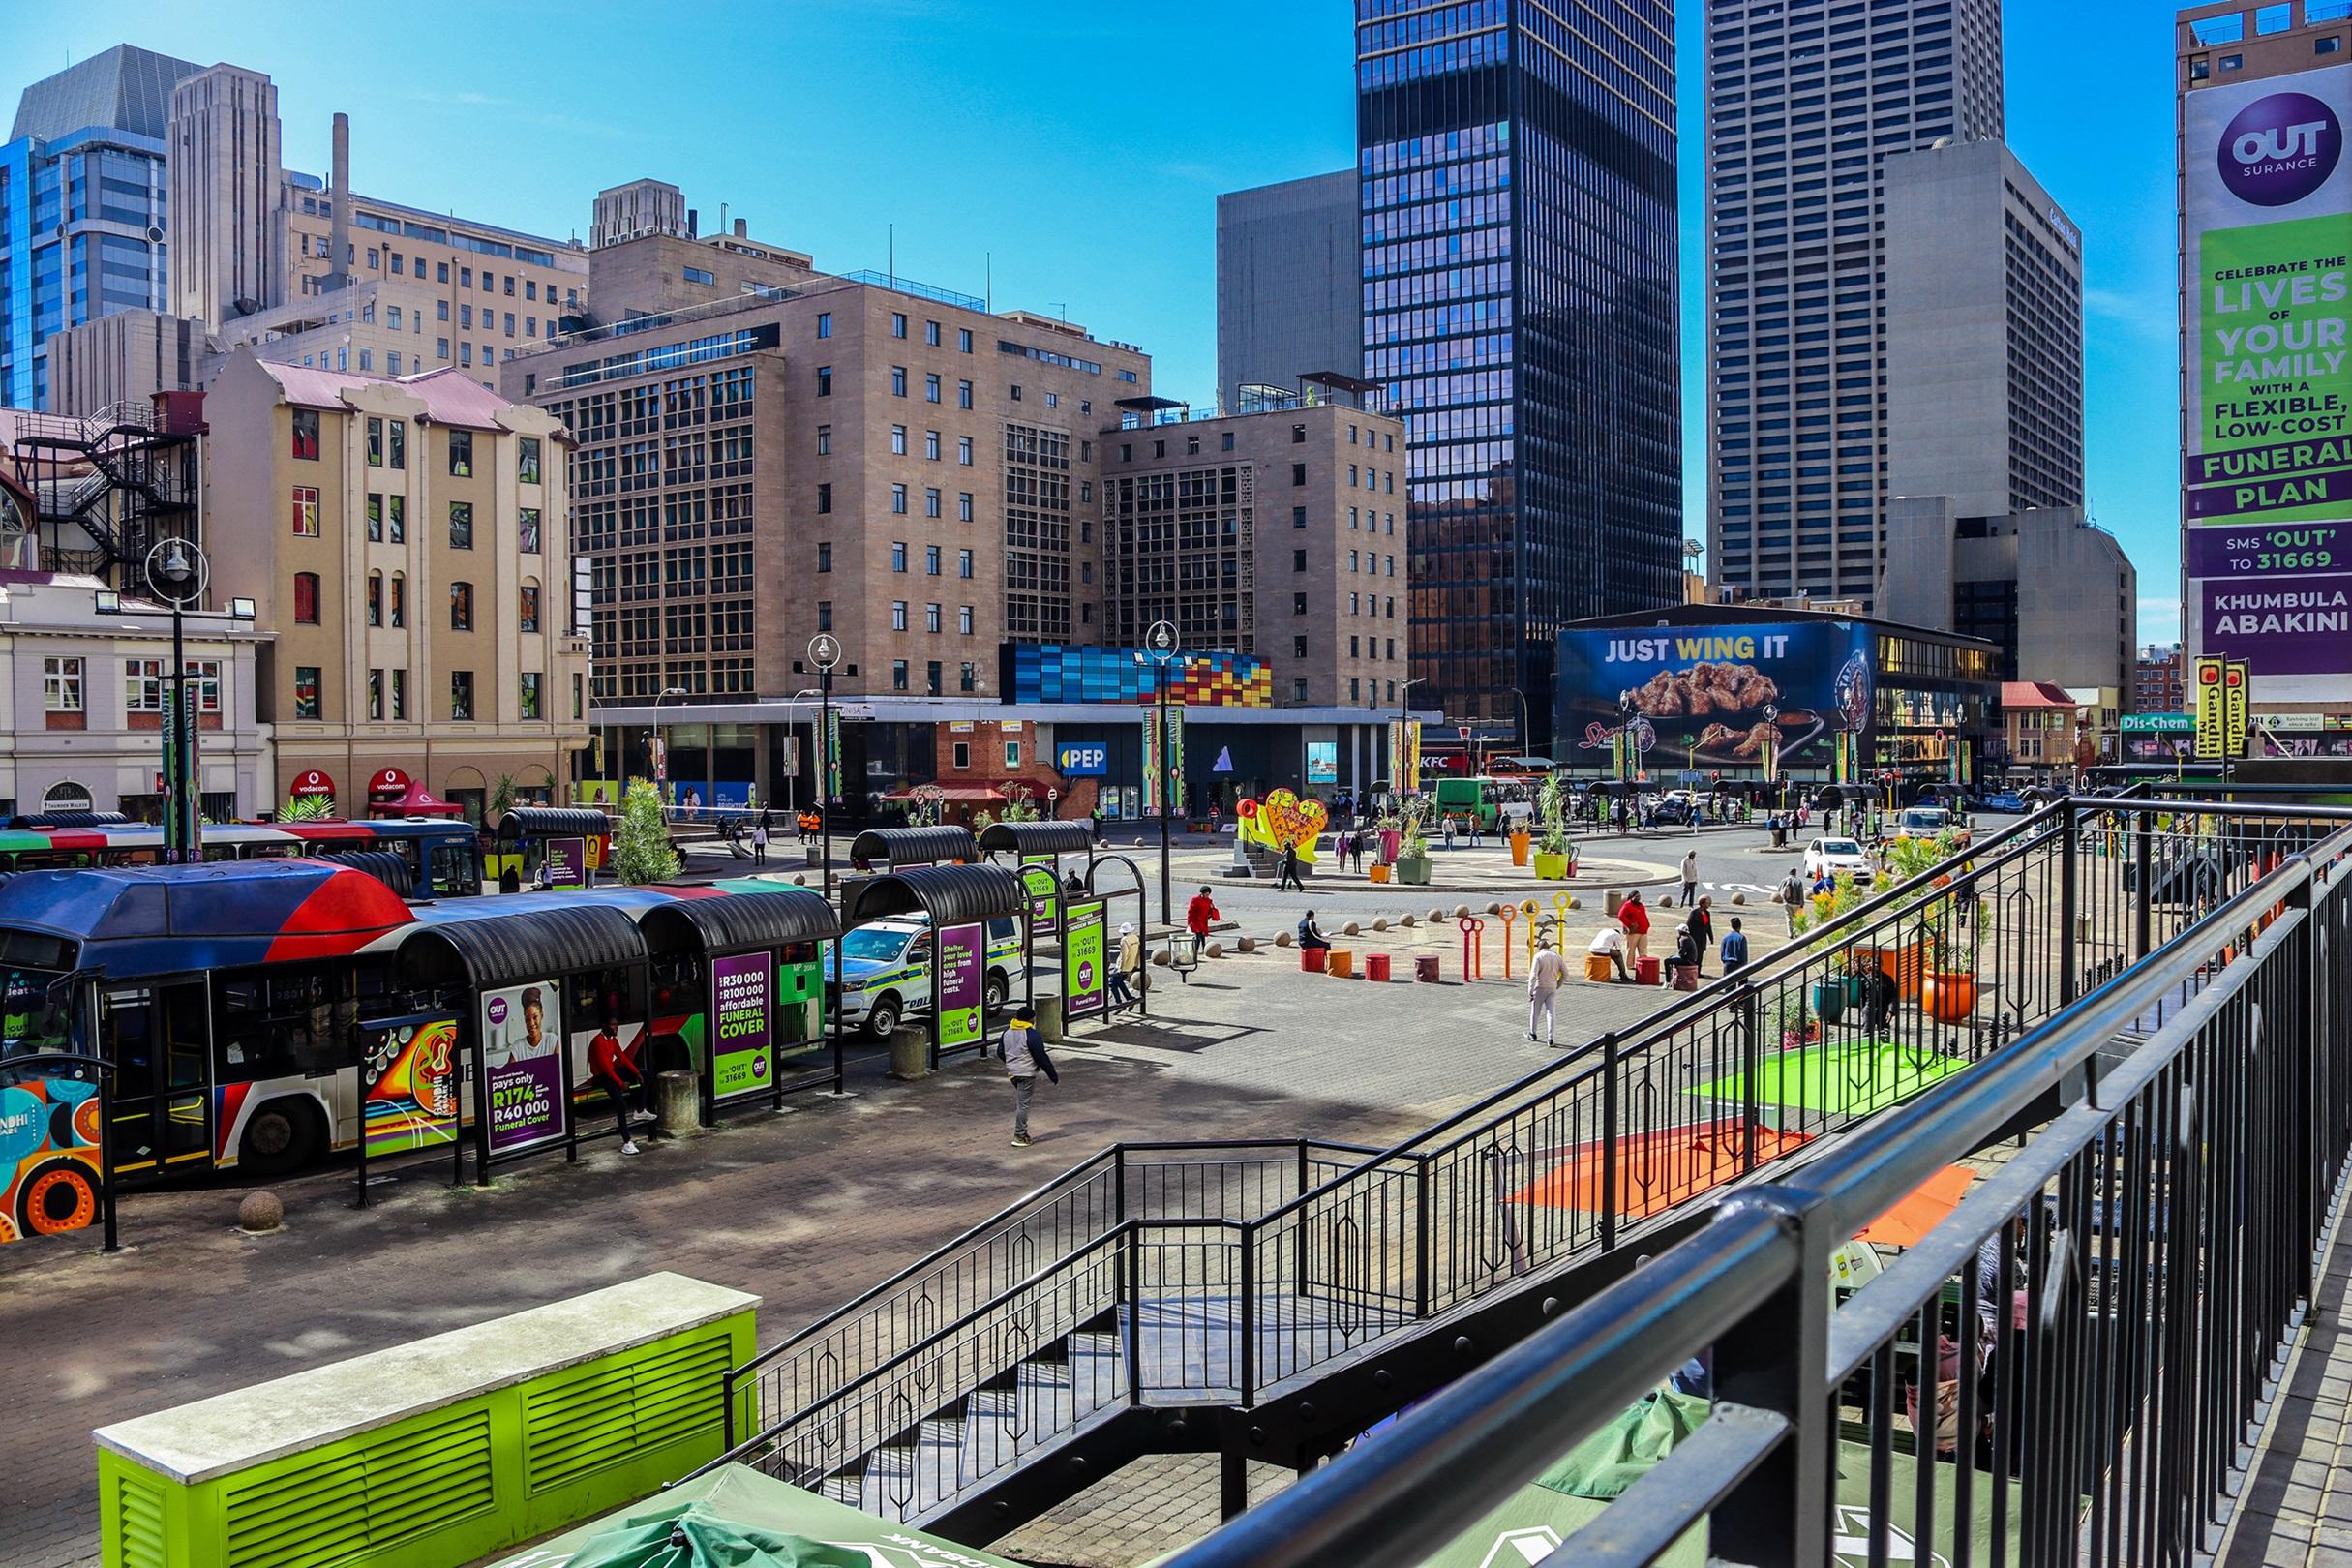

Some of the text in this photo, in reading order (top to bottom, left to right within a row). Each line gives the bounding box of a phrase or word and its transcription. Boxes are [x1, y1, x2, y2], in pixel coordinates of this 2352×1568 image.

[2232, 120, 2326, 165] OUT
[2243, 157, 2317, 176] SURANCE
[2214, 256, 2347, 281] CELEBRATE THE
[2214, 271, 2347, 314] LIVES
[2268, 310, 2290, 321] OF
[2214, 317, 2346, 357] YOUR
[2214, 350, 2347, 384] FAMILY
[2249, 381, 2310, 396] WITH A
[2215, 394, 2348, 420] FLEXIBLE,
[2215, 414, 2347, 439] LOW-COST
[2203, 438, 2352, 479] FUNERAL
[2235, 477, 2328, 509] PLAN
[2226, 537, 2260, 550] SMS
[2229, 551, 2332, 571] TO 31669
[2214, 590, 2348, 611] KHUMBULA
[2214, 611, 2348, 635] ABAKINI
[1605, 635, 1789, 663] JUST WING IT
[162, 692, 170, 744] GANDHI
[2124, 717, 2188, 729] Dis-Chem
[2208, 686, 2220, 755] Gandhi
[2230, 689, 2243, 753] Gandhi
[2198, 721, 2208, 755] Mall
[1070, 749, 1105, 769] PEP
[1420, 756, 1449, 768] KFC
[1035, 900, 1045, 909] OUT
[943, 944, 964, 953] Shelter
[943, 950, 973, 962] your loved
[1077, 946, 1096, 957] 31669
[723, 974, 743, 987] R30
[743, 971, 764, 984] 000
[943, 969, 956, 980] high
[943, 977, 964, 988] funeral
[1079, 968, 1091, 979] OUT
[723, 986, 745, 1000] R100
[746, 983, 764, 996] 000
[489, 1004, 506, 1014] OUT
[719, 996, 764, 1011] affordable
[910, 996, 932, 1008] POL
[719, 1007, 765, 1024] FUNERAL
[719, 1019, 765, 1040] COVER
[753, 1061, 766, 1070] OUT
[492, 1072, 535, 1092] pays only
[725, 1071, 746, 1083] 31669
[433, 1075, 443, 1115] GANDHI
[493, 1085, 535, 1109] R174
[0, 1113, 28, 1129] NDHI
[494, 1099, 550, 1124] R40 000
[495, 1114, 550, 1132] Funeral Cover
